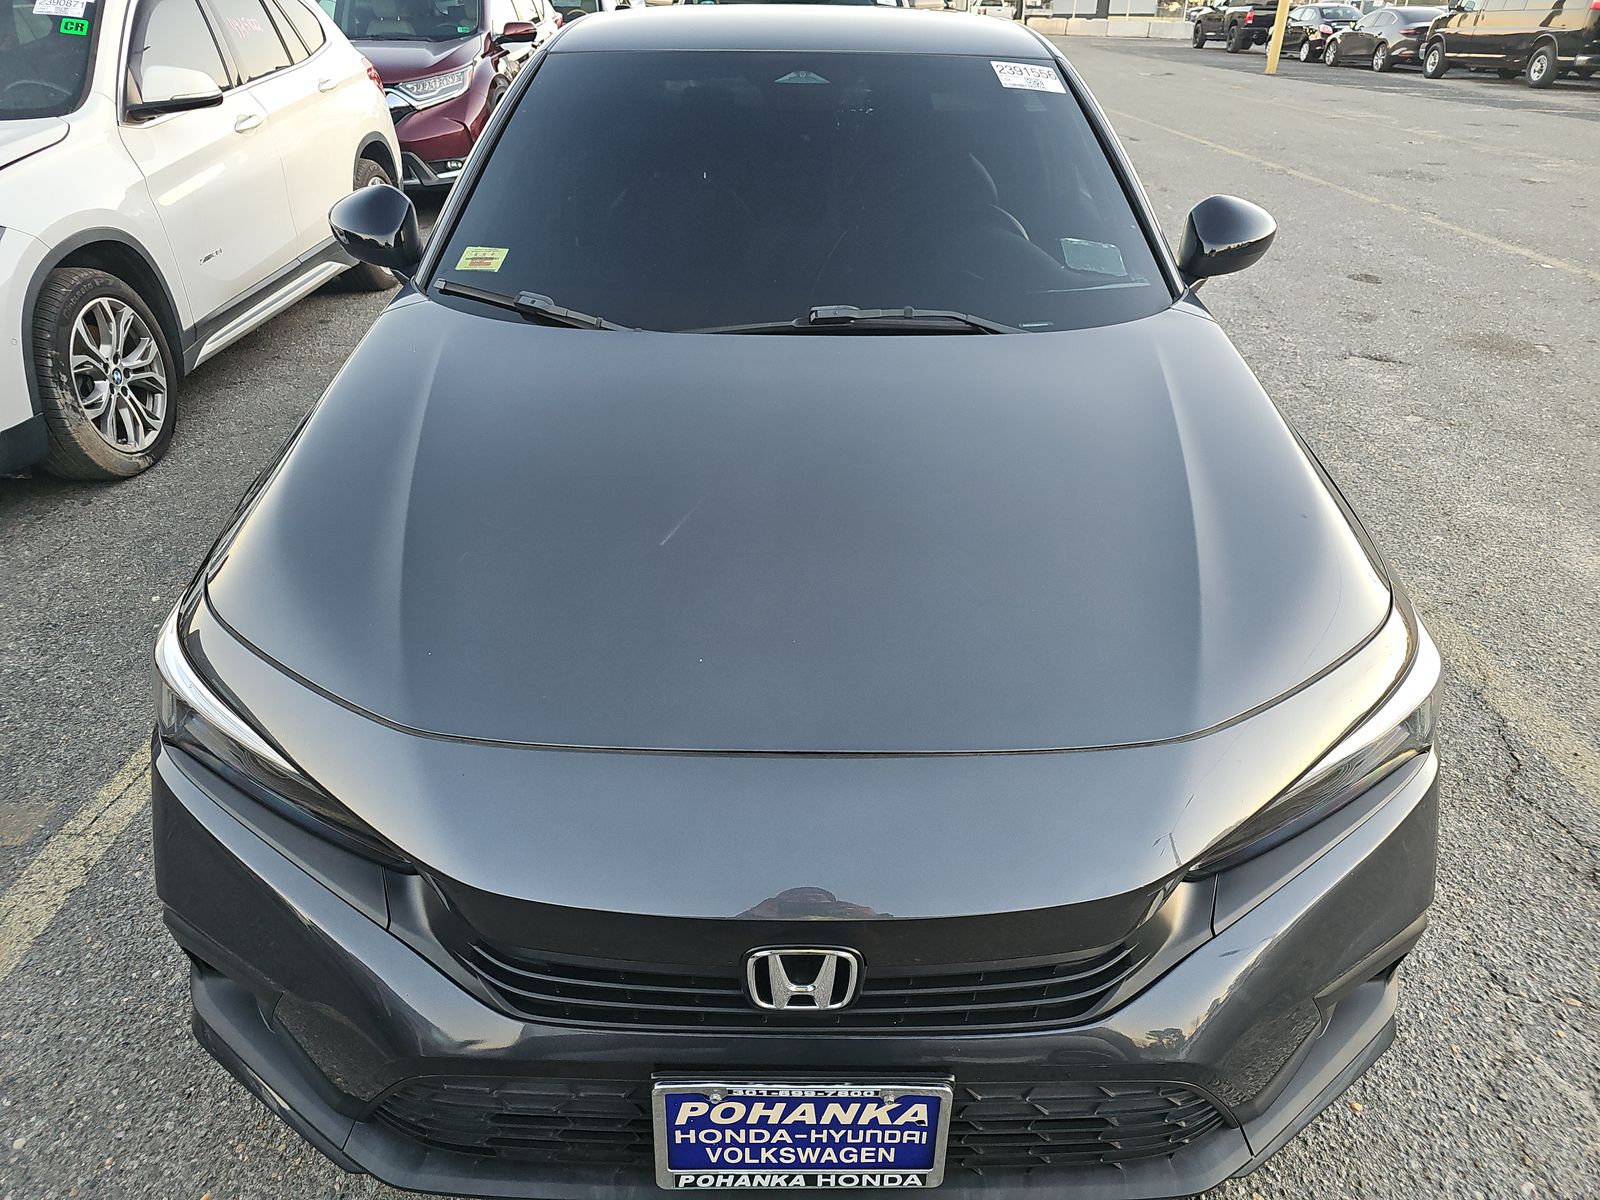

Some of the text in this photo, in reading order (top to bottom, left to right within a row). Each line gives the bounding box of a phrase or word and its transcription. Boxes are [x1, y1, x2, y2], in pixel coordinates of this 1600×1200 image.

[38, 0, 85, 8] 2390871
[64, 21, 85, 32] CR
[996, 64, 1057, 80] 2391556
[675, 1102, 928, 1127] POHANKA
[705, 1147, 896, 1164] VOLKSWAGEN
[678, 1173, 924, 1187] POHANKA HONDA
